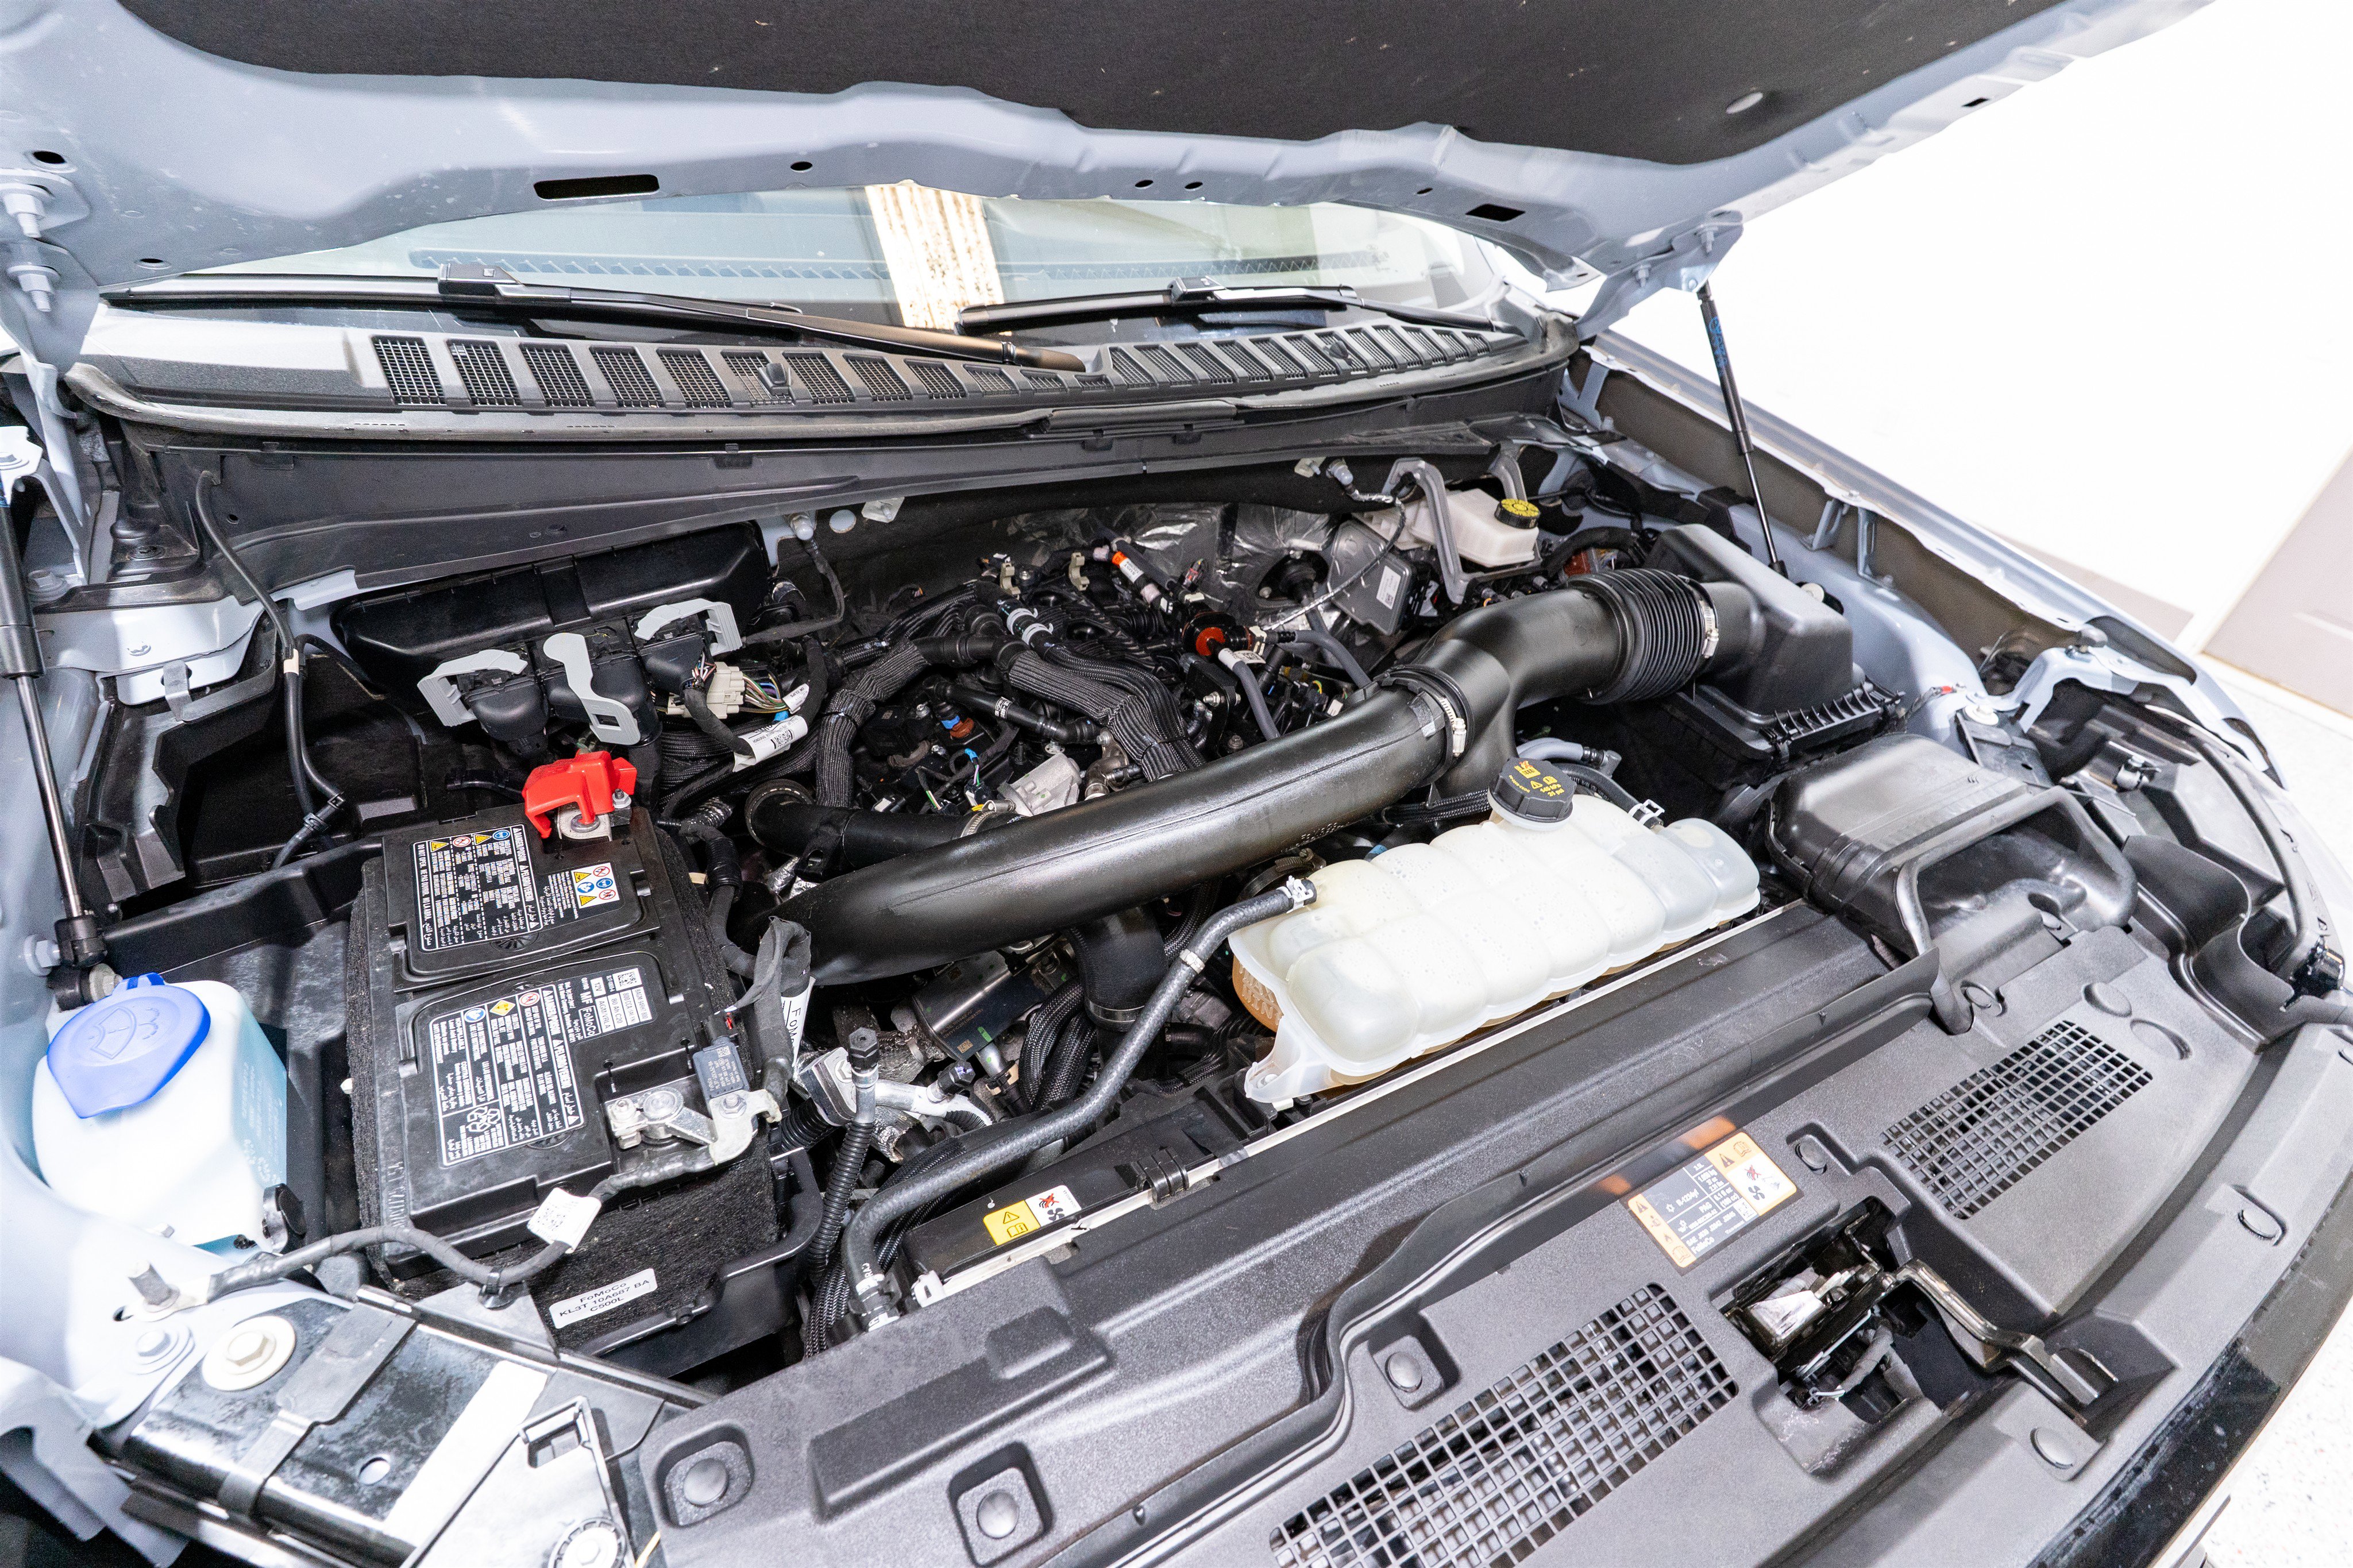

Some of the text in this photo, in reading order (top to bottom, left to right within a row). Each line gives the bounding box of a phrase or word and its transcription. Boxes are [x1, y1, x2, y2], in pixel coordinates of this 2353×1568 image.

[514, 832, 534, 902] DANGER/POISON PELIGRO/VENENO
[580, 991, 593, 1004] MF
[581, 1007, 596, 1036] FoMoCo
[544, 995, 572, 1089] DANGER/POISON PELIGRO/VENENO
[560, 1280, 649, 1316] KL3T 10A687 BA
[580, 1283, 626, 1303] FoMoCo
[590, 1297, 624, 1311] C500L
